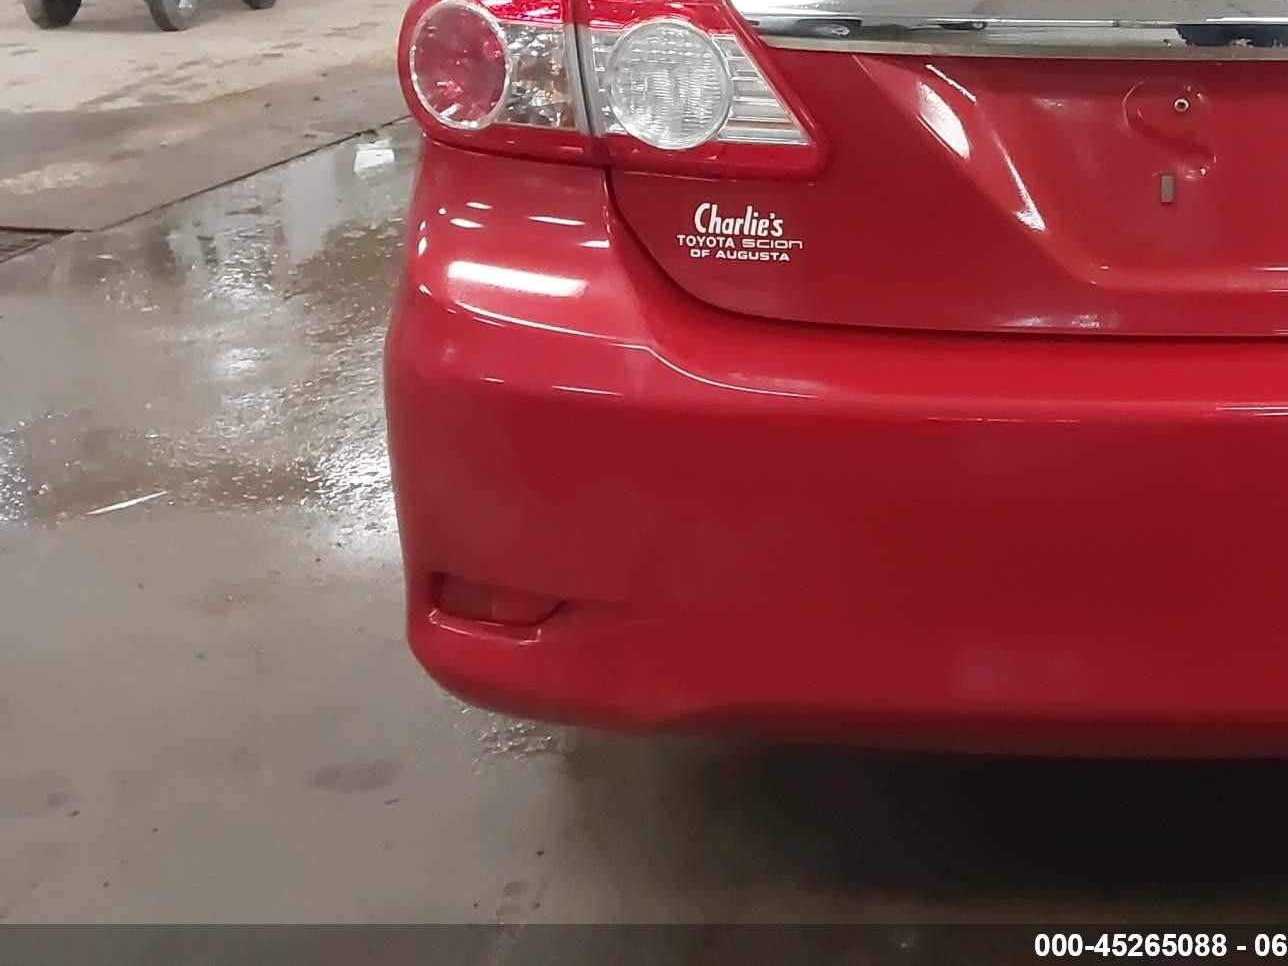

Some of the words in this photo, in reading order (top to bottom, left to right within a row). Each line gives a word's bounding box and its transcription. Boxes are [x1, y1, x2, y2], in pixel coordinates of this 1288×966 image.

[694, 202, 784, 237] Charlie's
[676, 234, 736, 249] TOYOTA
[690, 249, 711, 258] OF
[716, 250, 790, 262] AUGUSTA
